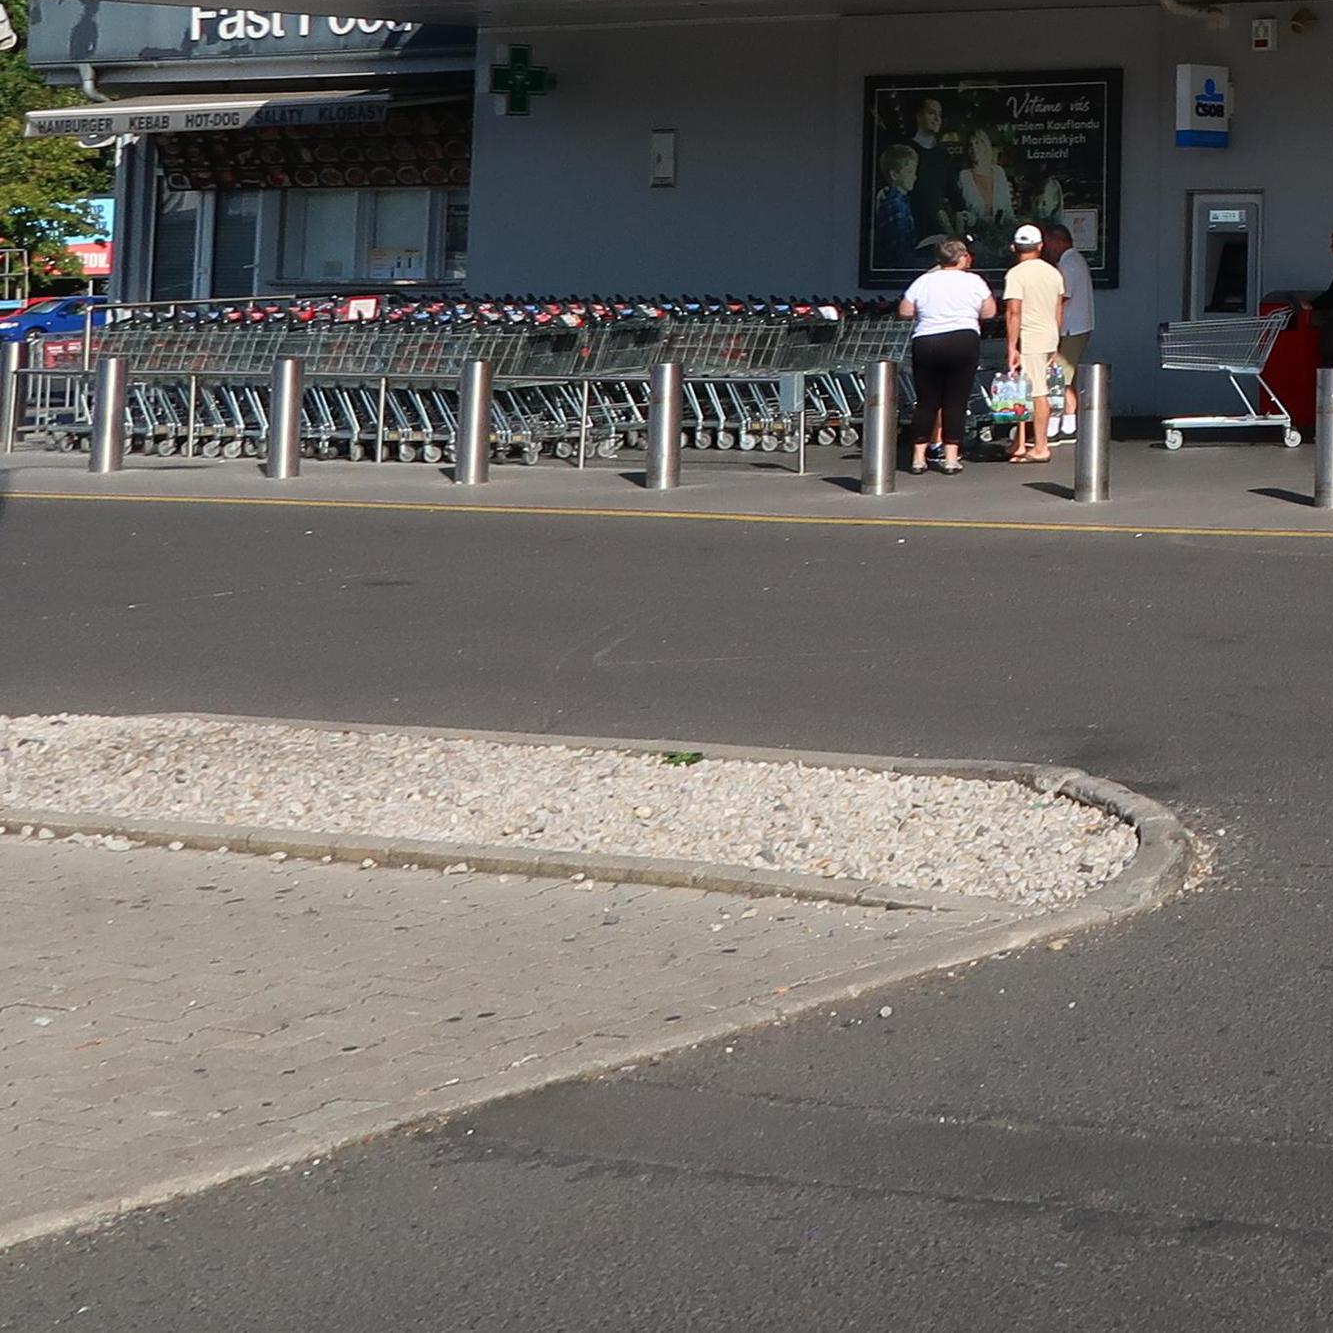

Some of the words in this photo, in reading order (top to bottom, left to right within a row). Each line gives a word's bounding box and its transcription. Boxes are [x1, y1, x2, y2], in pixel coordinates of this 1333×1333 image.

[38, 117, 113, 135] HAMBURGER
[128, 115, 170, 131] KEBAB
[185, 112, 240, 128] HOT-DOG
[1046, 117, 1100, 130] Kauflandu
